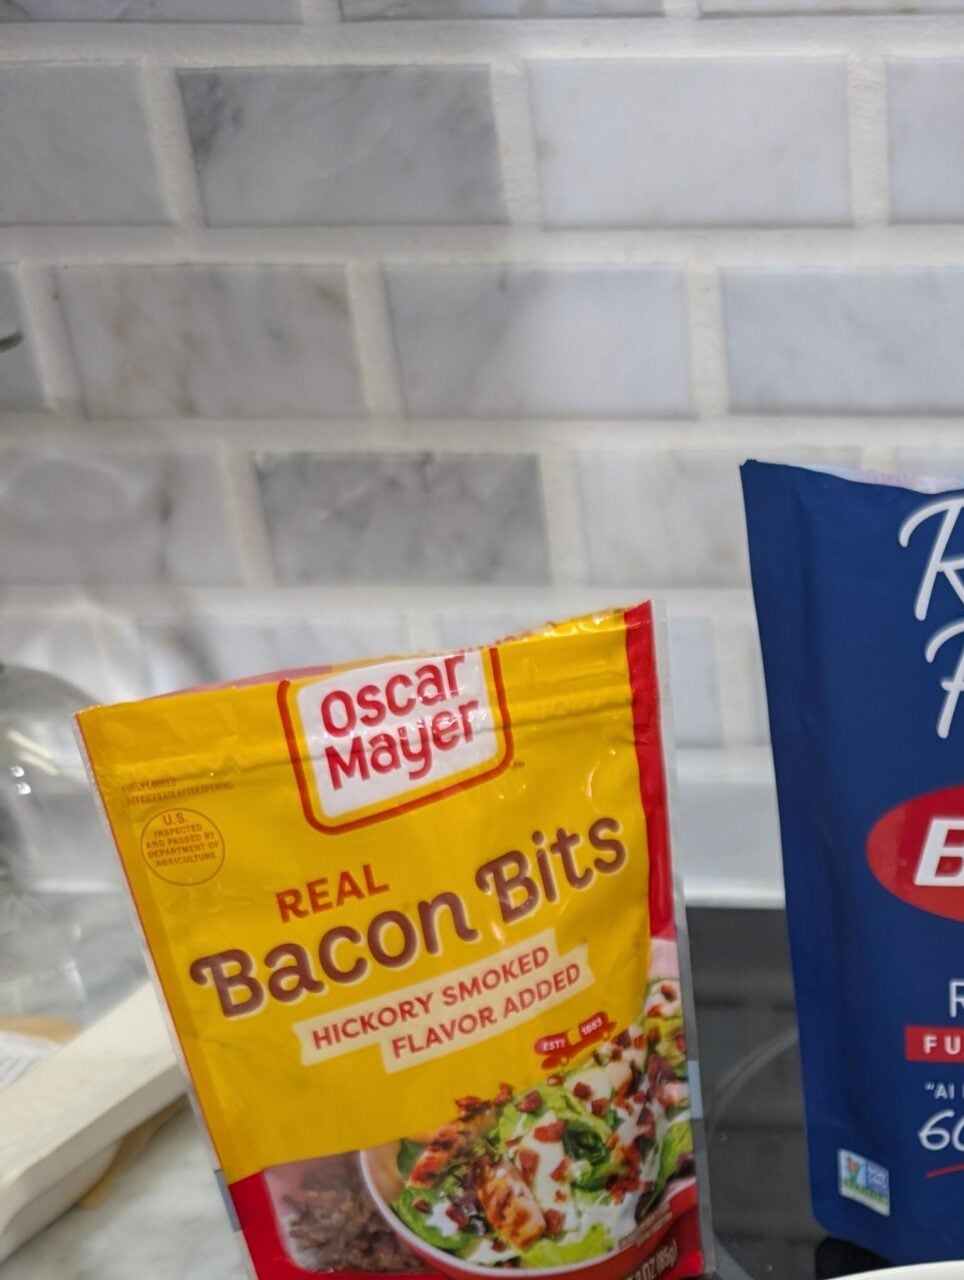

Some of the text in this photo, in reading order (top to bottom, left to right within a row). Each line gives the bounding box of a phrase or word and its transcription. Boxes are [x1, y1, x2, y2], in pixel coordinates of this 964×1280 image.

[321, 650, 465, 738] Oscar
[325, 700, 479, 791] Mayer
[146, 832, 215, 850] AND PASSED BY
[147, 842, 205, 859] DEPARTMENT
[163, 812, 188, 826] U.S.
[190, 818, 628, 1018] Bacon Bits
[275, 864, 390, 923] REAL
[312, 945, 550, 1050] HICKORY SMOKED
[392, 963, 581, 1059] FLAVOR ADDED
